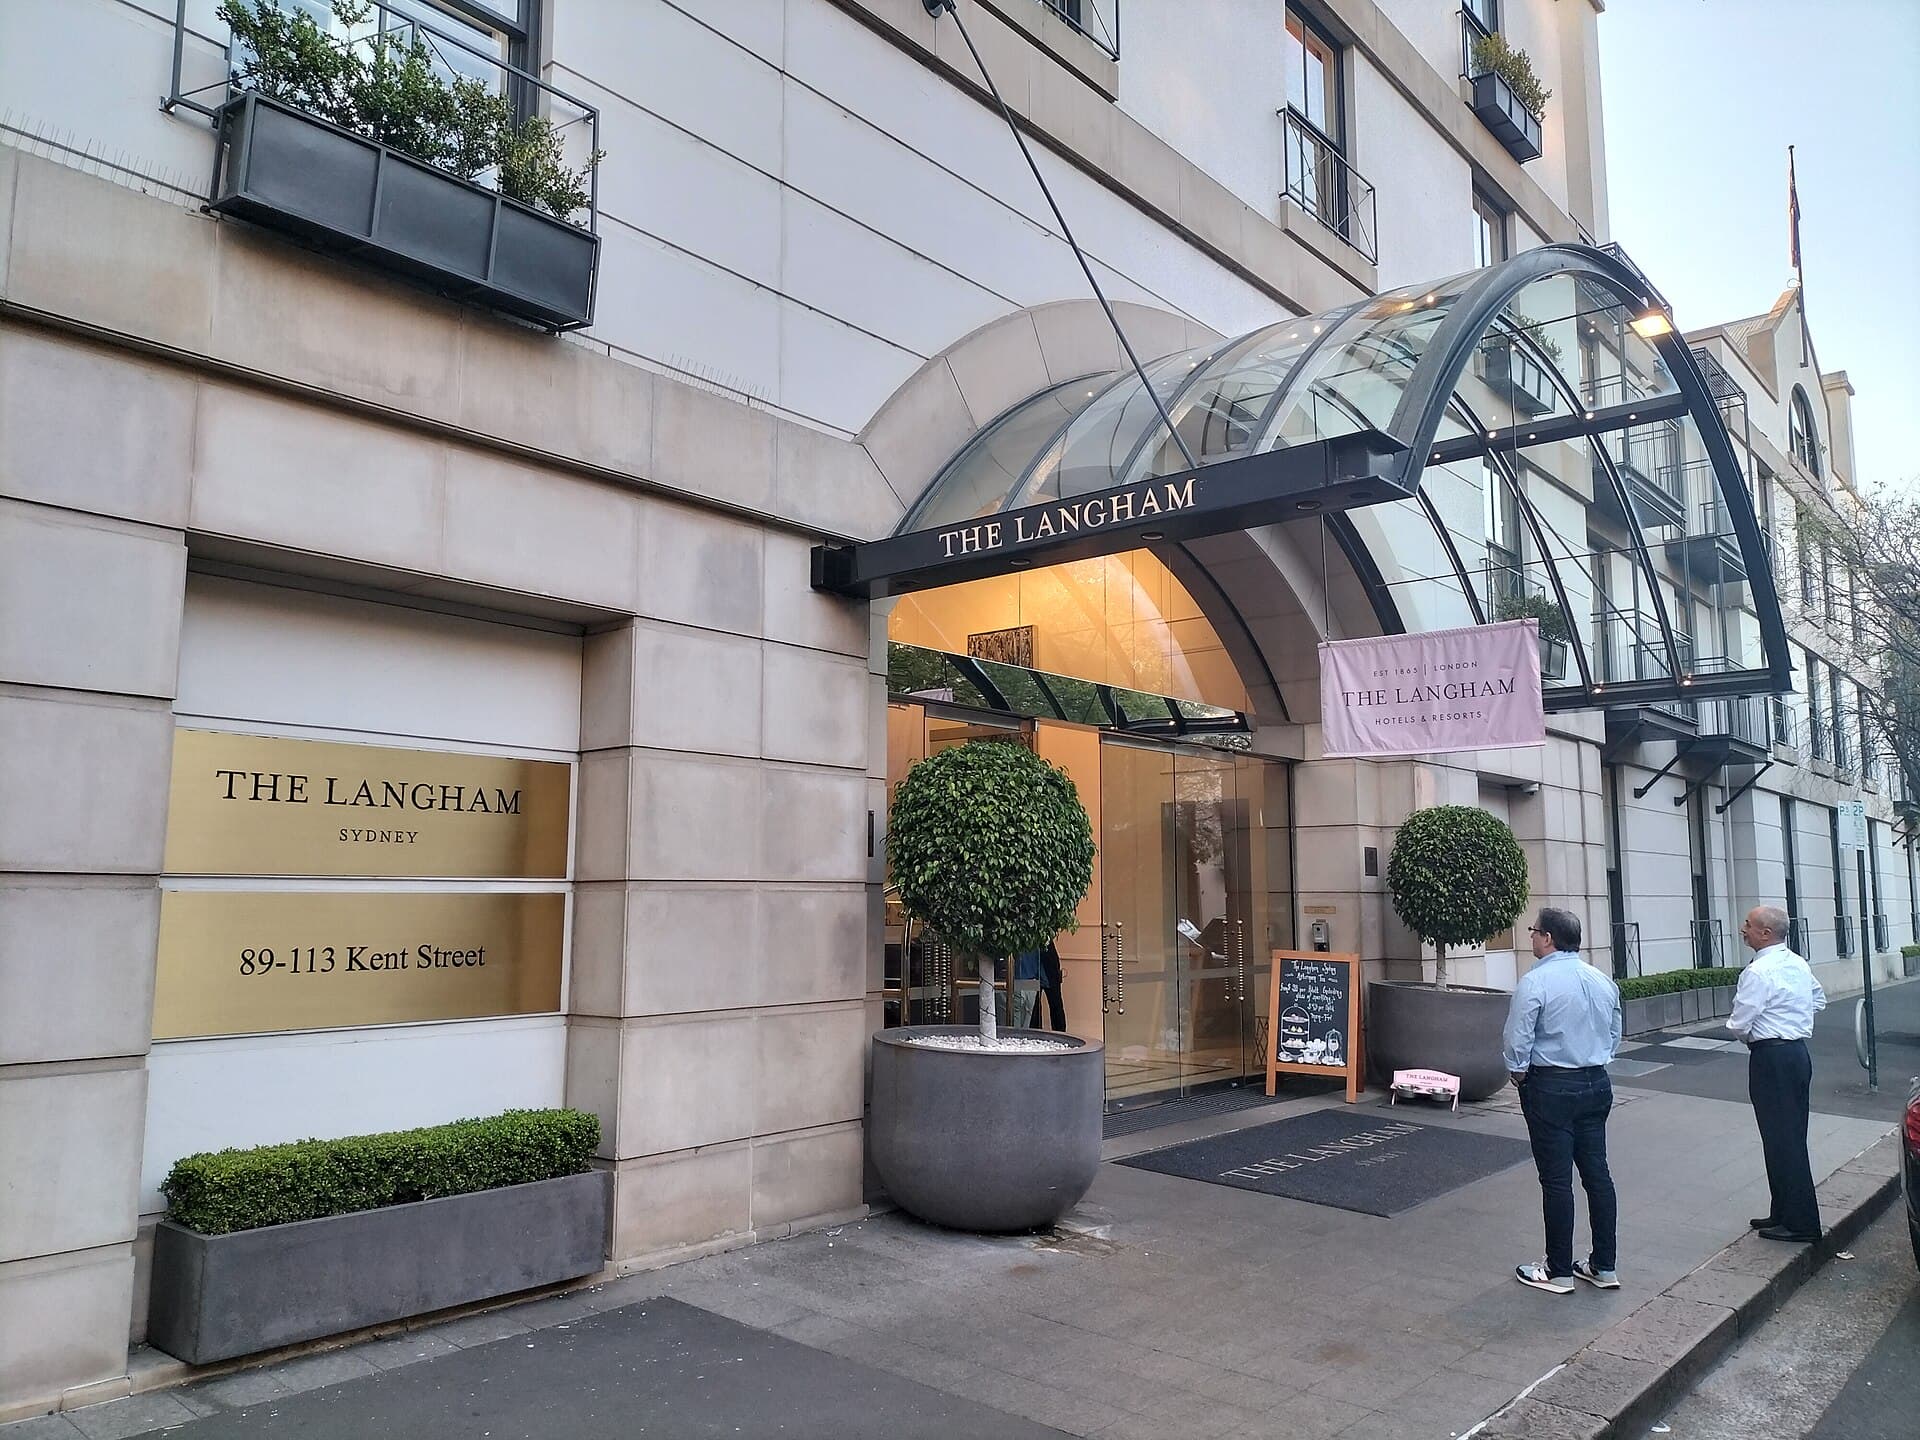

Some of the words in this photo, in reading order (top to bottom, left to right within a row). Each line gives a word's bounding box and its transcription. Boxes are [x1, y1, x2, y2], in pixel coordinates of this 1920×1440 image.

[939, 522, 1003, 558] THE
[1014, 478, 1197, 544] LANGHAM
[1373, 669, 1388, 677] EST
[1395, 667, 1418, 676] 1865
[1433, 661, 1479, 672] LONDON
[1342, 689, 1388, 707] THE
[1396, 677, 1516, 704] LANGHAM
[1375, 715, 1416, 726] HOTELS
[1421, 714, 1427, 723] &
[1432, 711, 1482, 722] RESORTS
[215, 770, 309, 804] THE
[324, 777, 522, 815] LANGHAM
[339, 828, 419, 844] SYDNEY
[239, 947, 336, 976] 89-113
[345, 946, 408, 972] Kent
[416, 943, 486, 969] Street
[1419, 1074, 1448, 1082] LANGHAM
[1219, 1158, 1303, 1180] THE
[1285, 1122, 1424, 1162] LANGHAM
